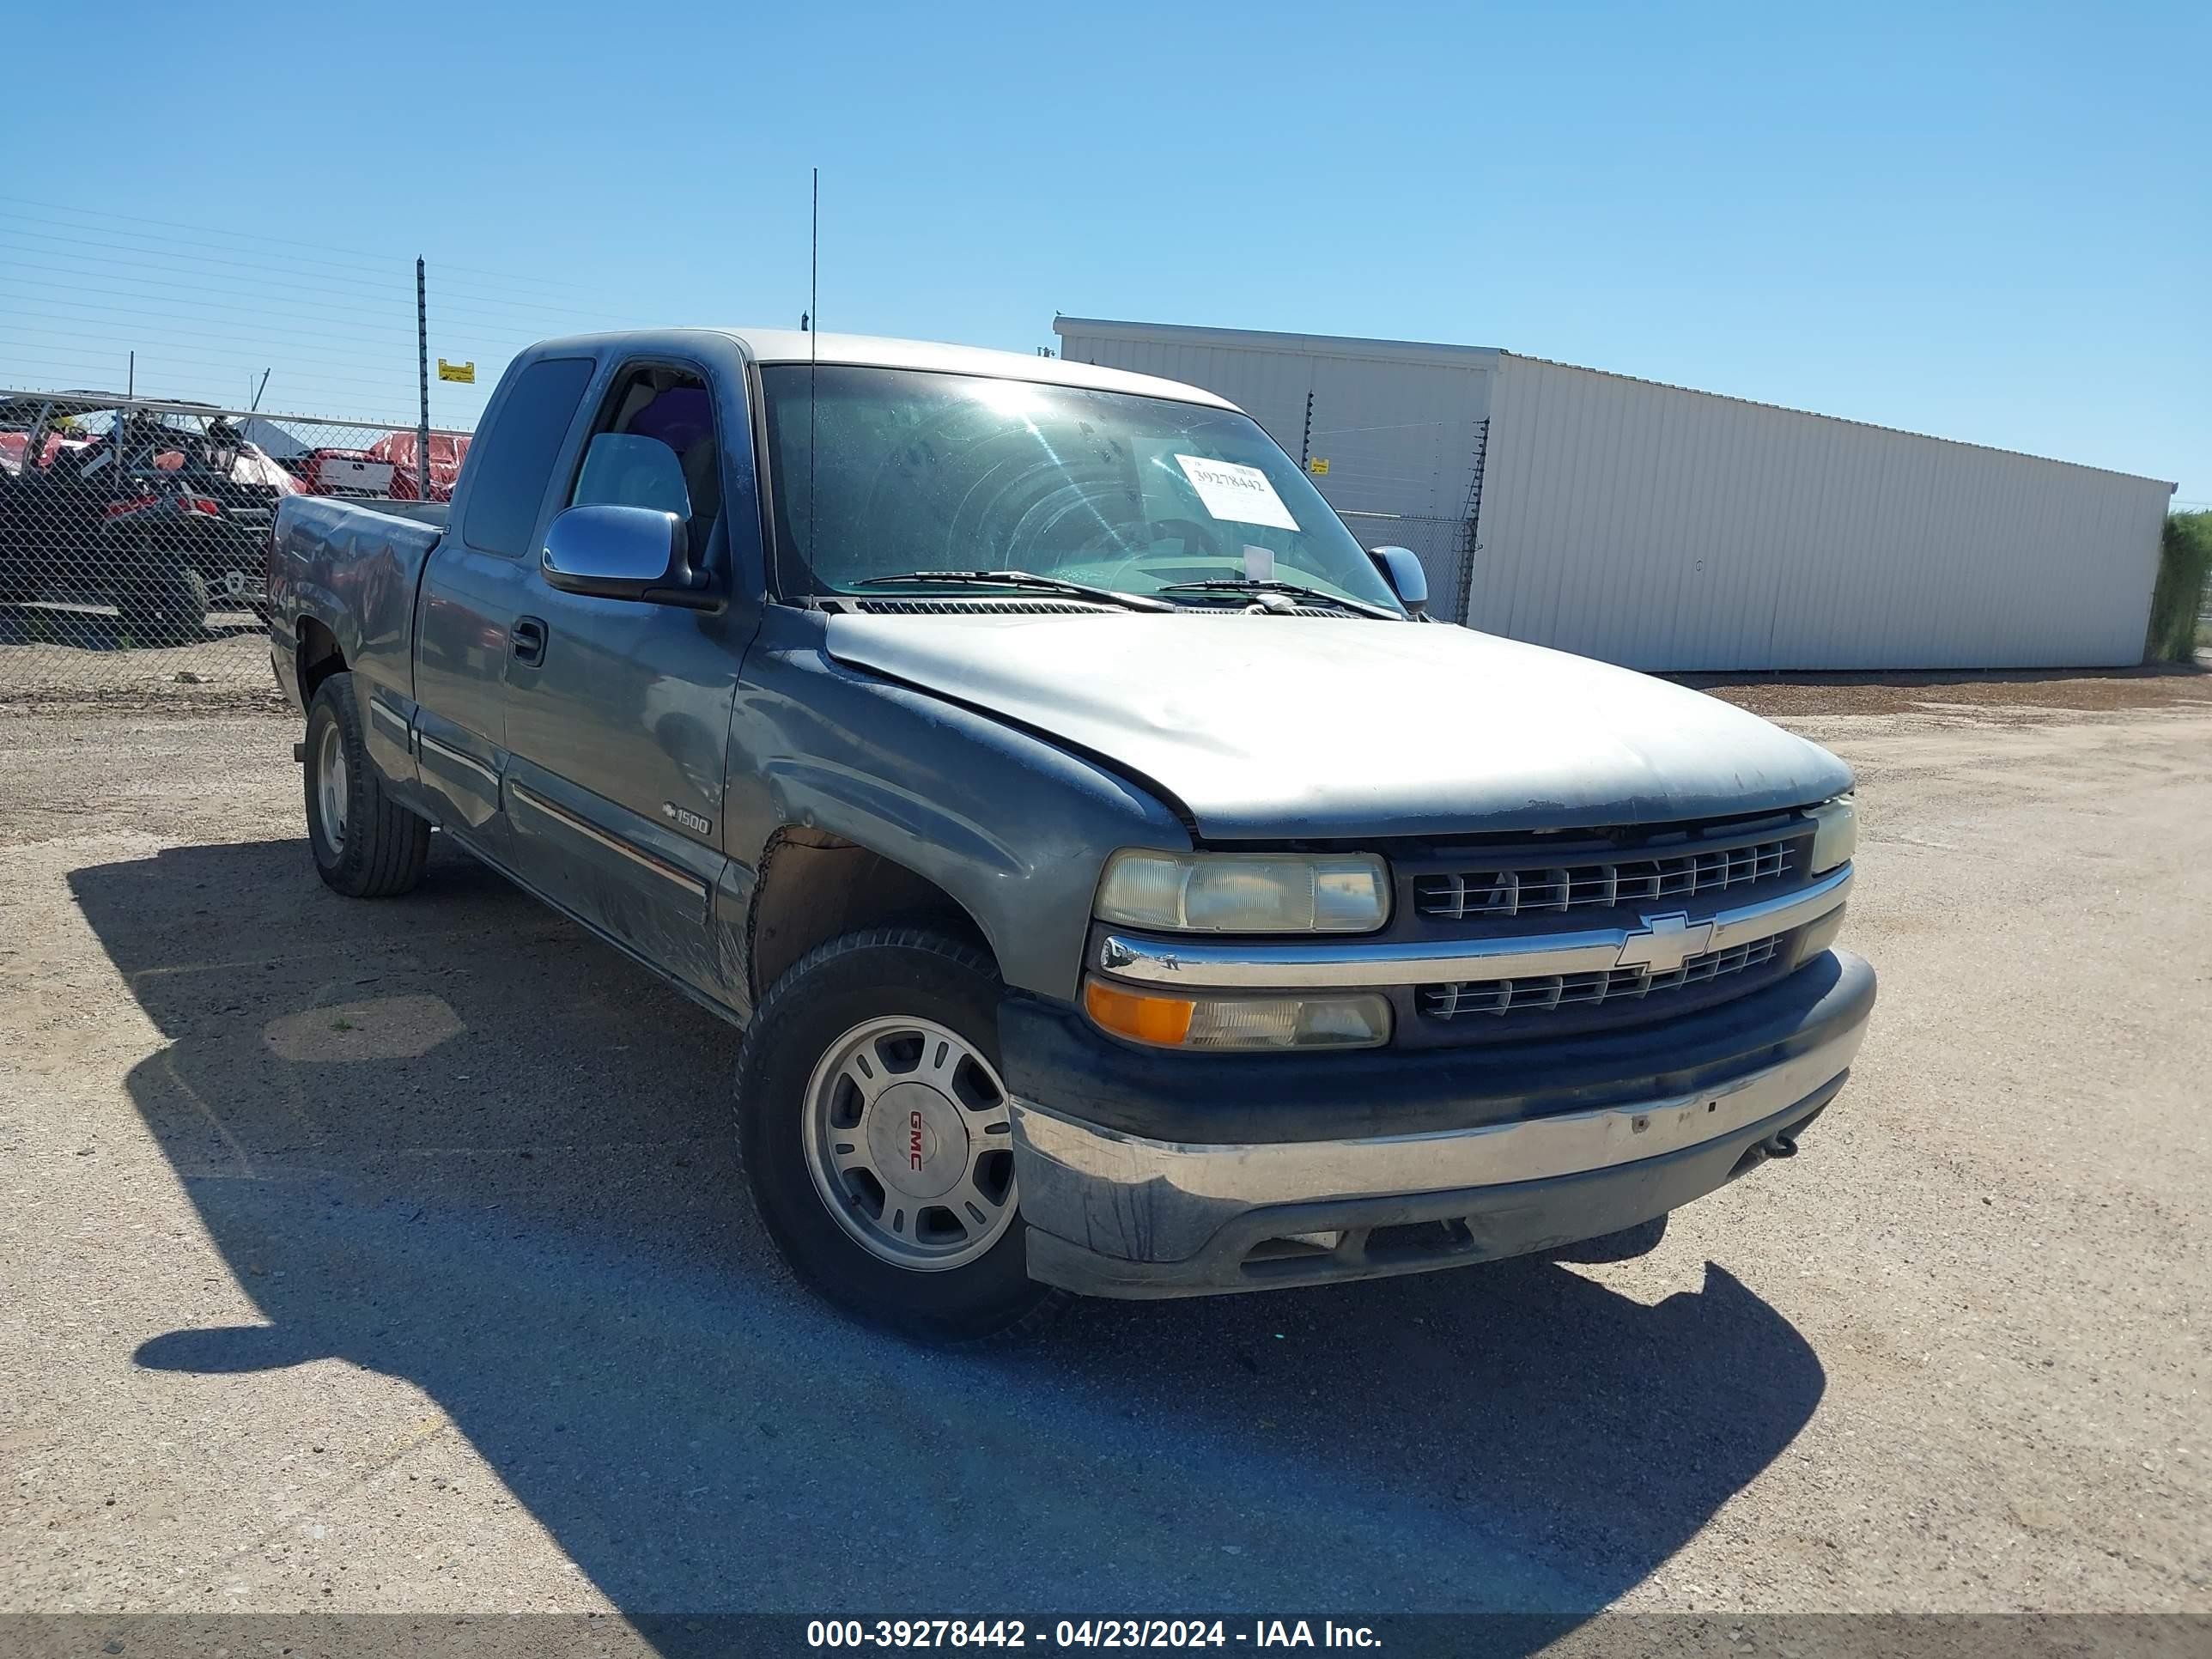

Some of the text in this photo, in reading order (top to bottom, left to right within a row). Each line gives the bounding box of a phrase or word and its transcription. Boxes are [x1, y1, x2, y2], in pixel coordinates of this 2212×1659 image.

[1194, 470, 1264, 491] 39278442
[678, 809, 708, 833] 1500
[909, 1110, 923, 1172] GMC
